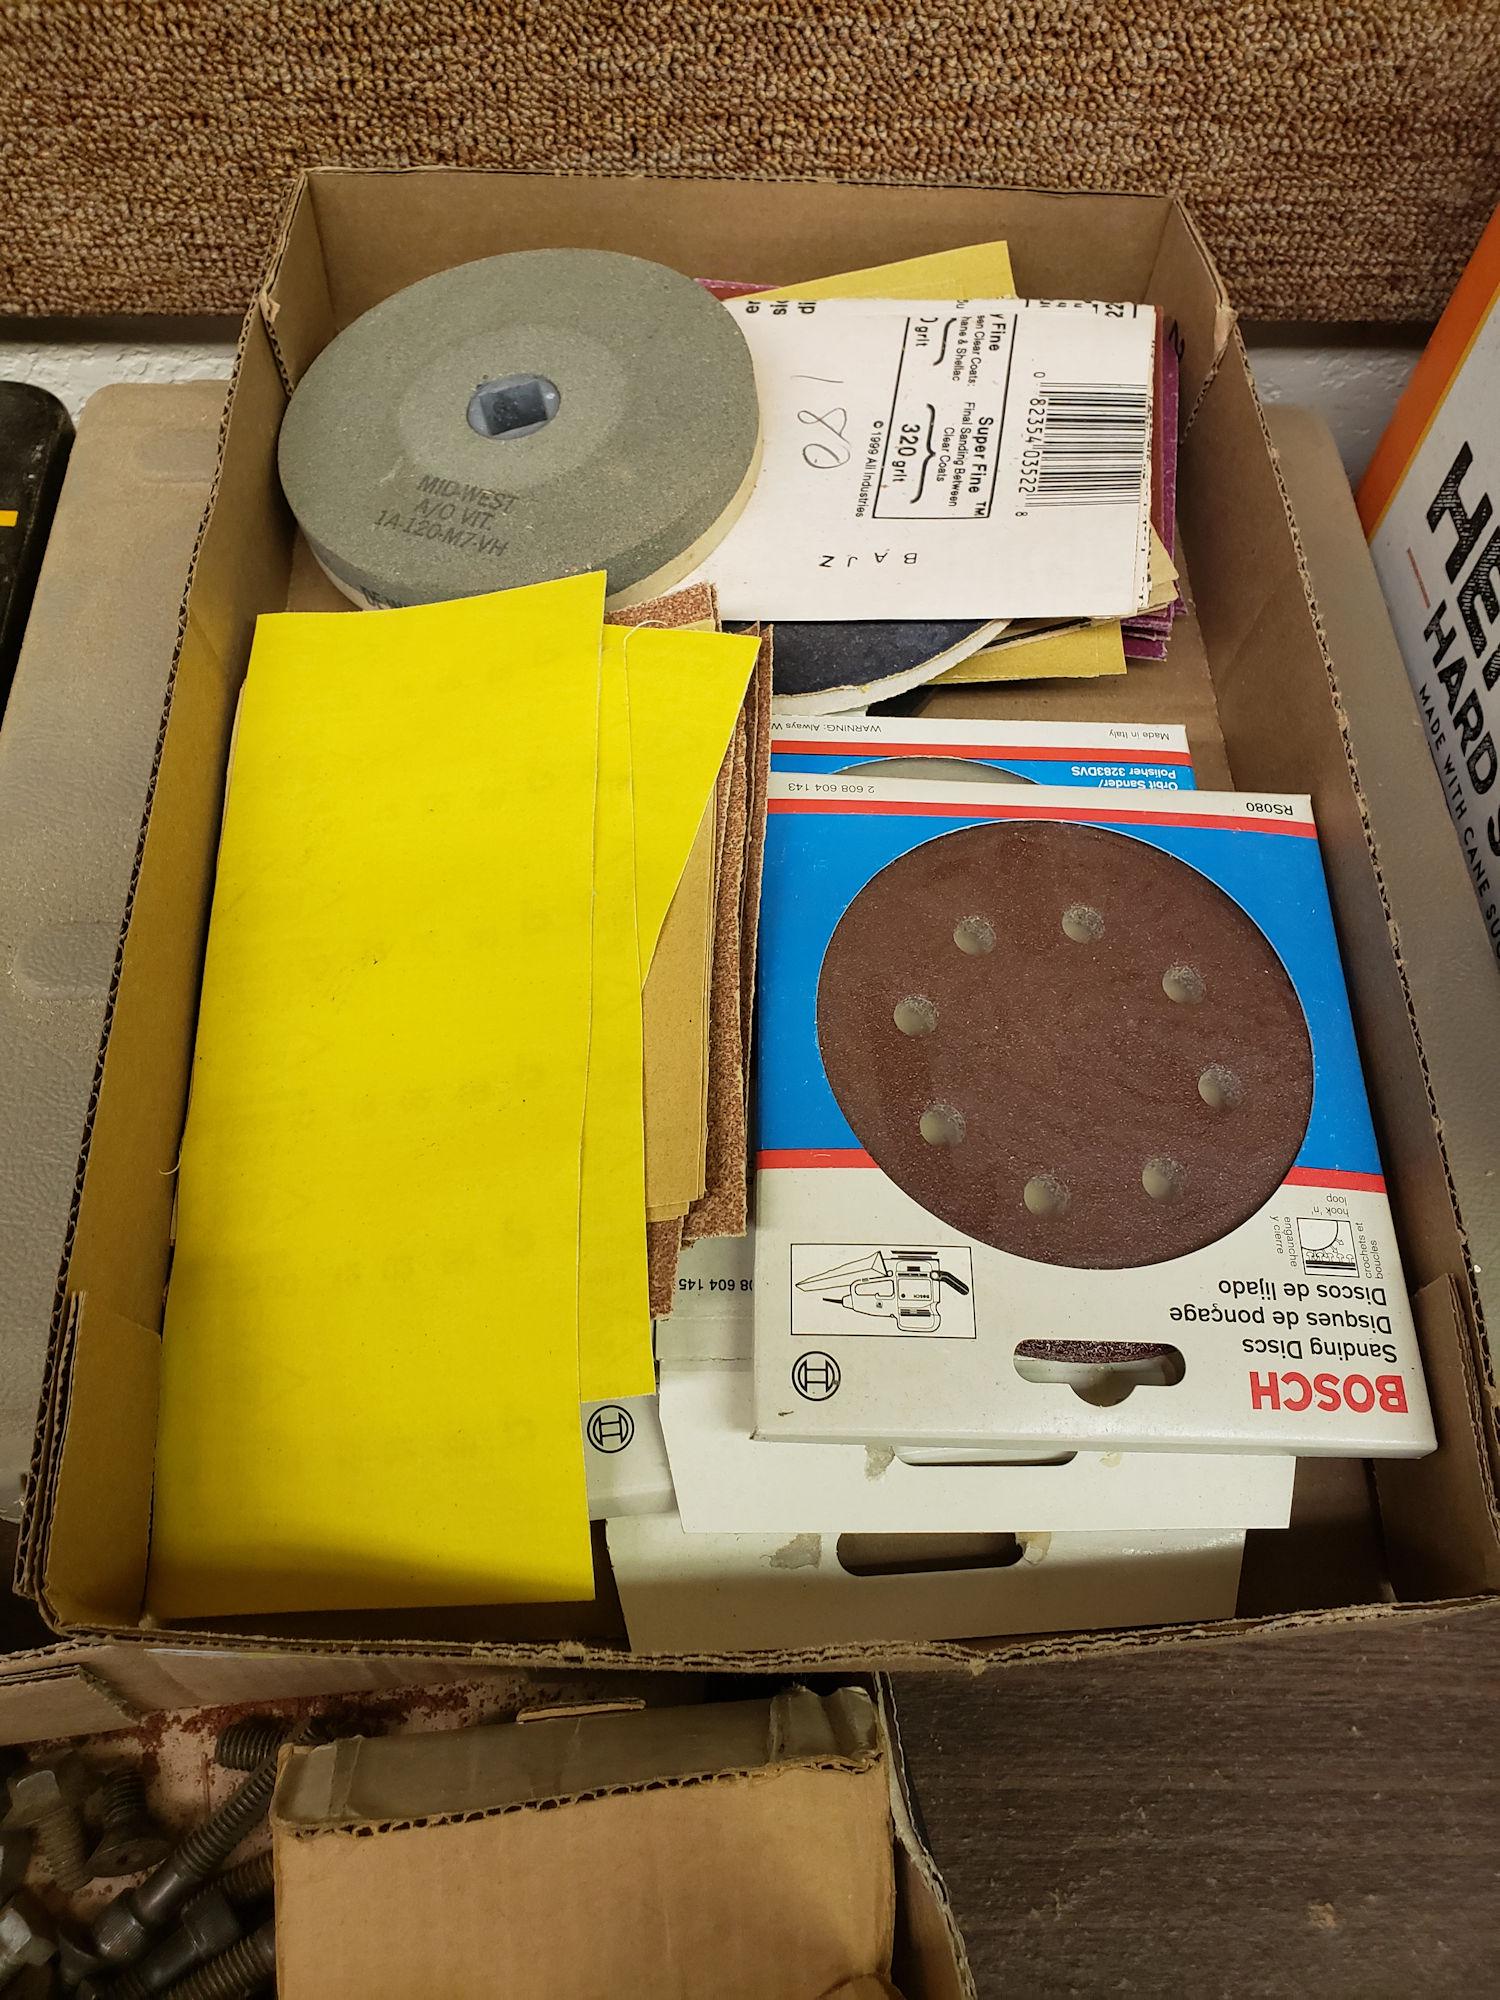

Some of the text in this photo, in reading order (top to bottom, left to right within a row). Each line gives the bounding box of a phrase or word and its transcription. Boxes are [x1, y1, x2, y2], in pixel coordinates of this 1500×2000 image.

[972, 331, 985, 355] Clear
[988, 323, 1006, 351] Fine
[952, 348, 967, 382] Shellac
[1025, 398, 1047, 443] 82354
[867, 431, 882, 455] 1999
[974, 416, 994, 460] Super
[892, 423, 921, 482] 320 grit
[936, 427, 955, 482] Clear Coats
[948, 402, 976, 507] Final Sanding Between
[968, 464, 987, 493] Fine
[1018, 450, 1041, 493] 03522
[855, 472, 875, 518] Industries
[1424, 600, 1497, 794] HARD
[785, 721, 820, 732] Always
[824, 724, 882, 733] WARNING:
[1109, 729, 1128, 739] Italy
[1143, 731, 1170, 740] Made
[1071, 766, 1176, 779] Polisher 3283DVS
[1098, 779, 1178, 790] Orbit Sander/
[788, 782, 875, 793] 2 608 604 143
[1419, 684, 1446, 751] MADE
[1444, 754, 1468, 820] WITH
[1464, 827, 1490, 898] CANE
[1246, 801, 1294, 816] RS080
[1325, 1207, 1349, 1217] hook
[1326, 1193, 1347, 1206] loop
[1273, 1224, 1284, 1254] cierre
[1284, 1216, 1299, 1268] enganche
[1355, 1222, 1372, 1279] crochets et
[1370, 1240, 1384, 1279] boucles
[679, 1278, 703, 1291] 145
[709, 1279, 735, 1291] 604
[1218, 1278, 1387, 1306] Discos de lijado
[1169, 1303, 1393, 1334] Disques de ponçage
[1242, 1337, 1398, 1363] Sanding Discs
[1249, 1371, 1409, 1414] BOSCH
